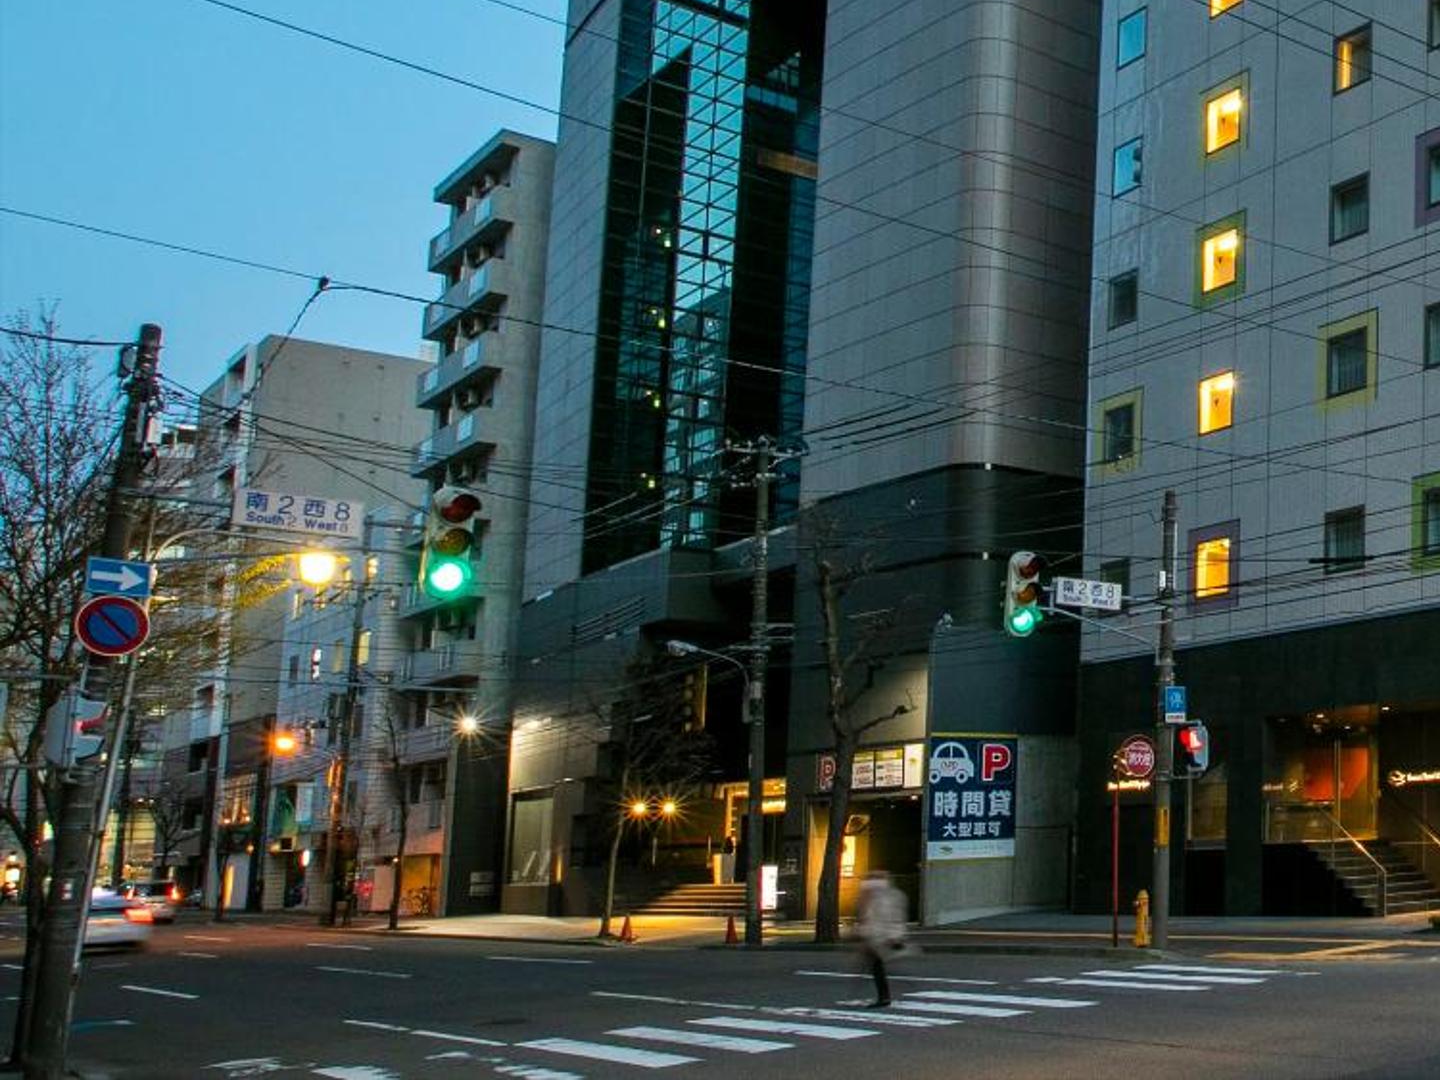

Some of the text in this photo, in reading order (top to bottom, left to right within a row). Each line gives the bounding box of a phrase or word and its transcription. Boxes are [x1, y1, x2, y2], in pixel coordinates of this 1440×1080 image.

[246, 492, 350, 521] 南2西8
[246, 511, 284, 525] South
[304, 519, 337, 531] West
[982, 744, 1011, 781] P
[934, 790, 1011, 818] 時間貸
[943, 821, 1001, 837] 大型車可
